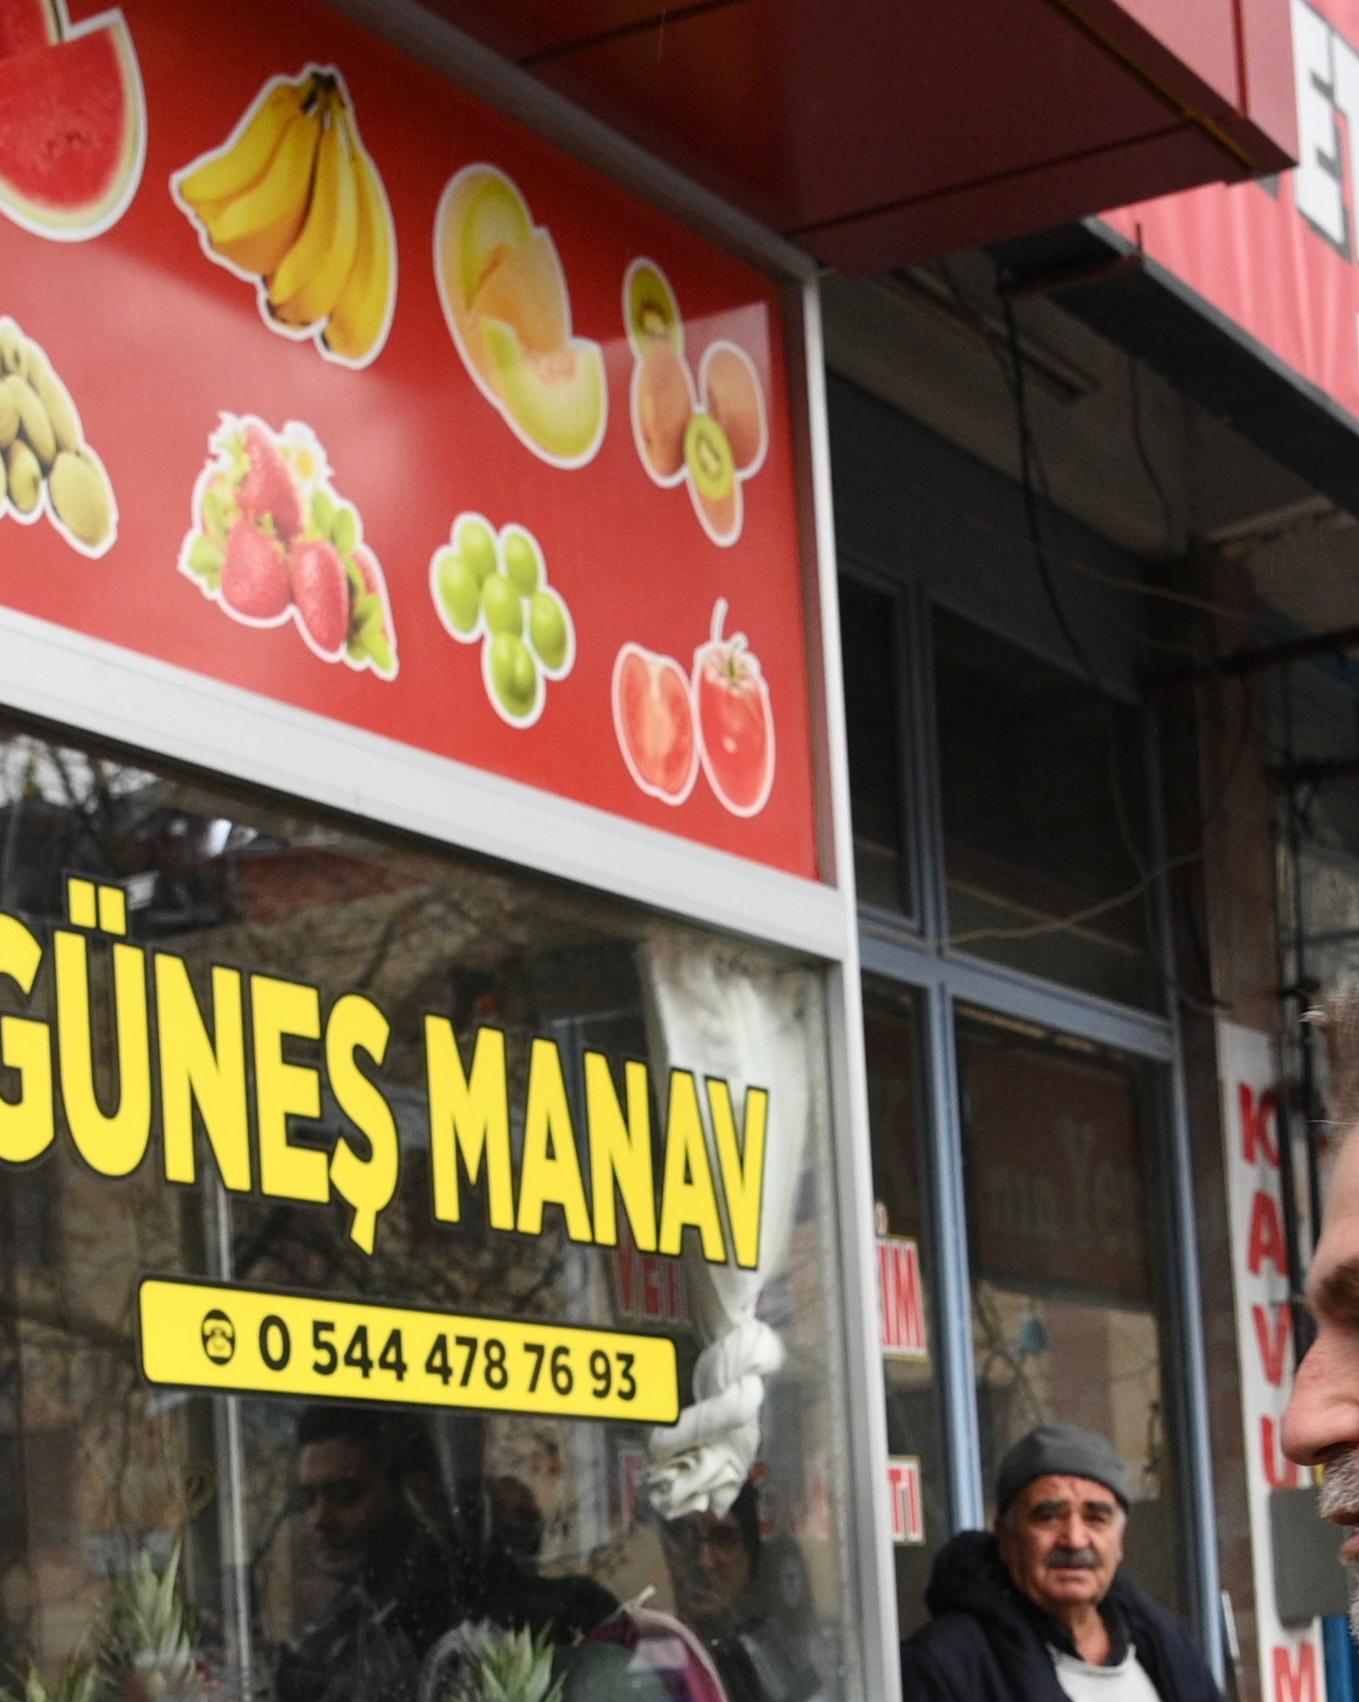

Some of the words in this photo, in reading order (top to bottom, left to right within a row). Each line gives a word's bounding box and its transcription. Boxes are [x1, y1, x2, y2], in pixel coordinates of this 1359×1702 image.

[424, 1014, 769, 1269] MANAV
[258, 1314, 292, 1372] 0
[311, 1320, 408, 1382] 544
[424, 1333, 509, 1391] 478
[523, 1342, 575, 1397] 76
[589, 1349, 638, 1402] 93
